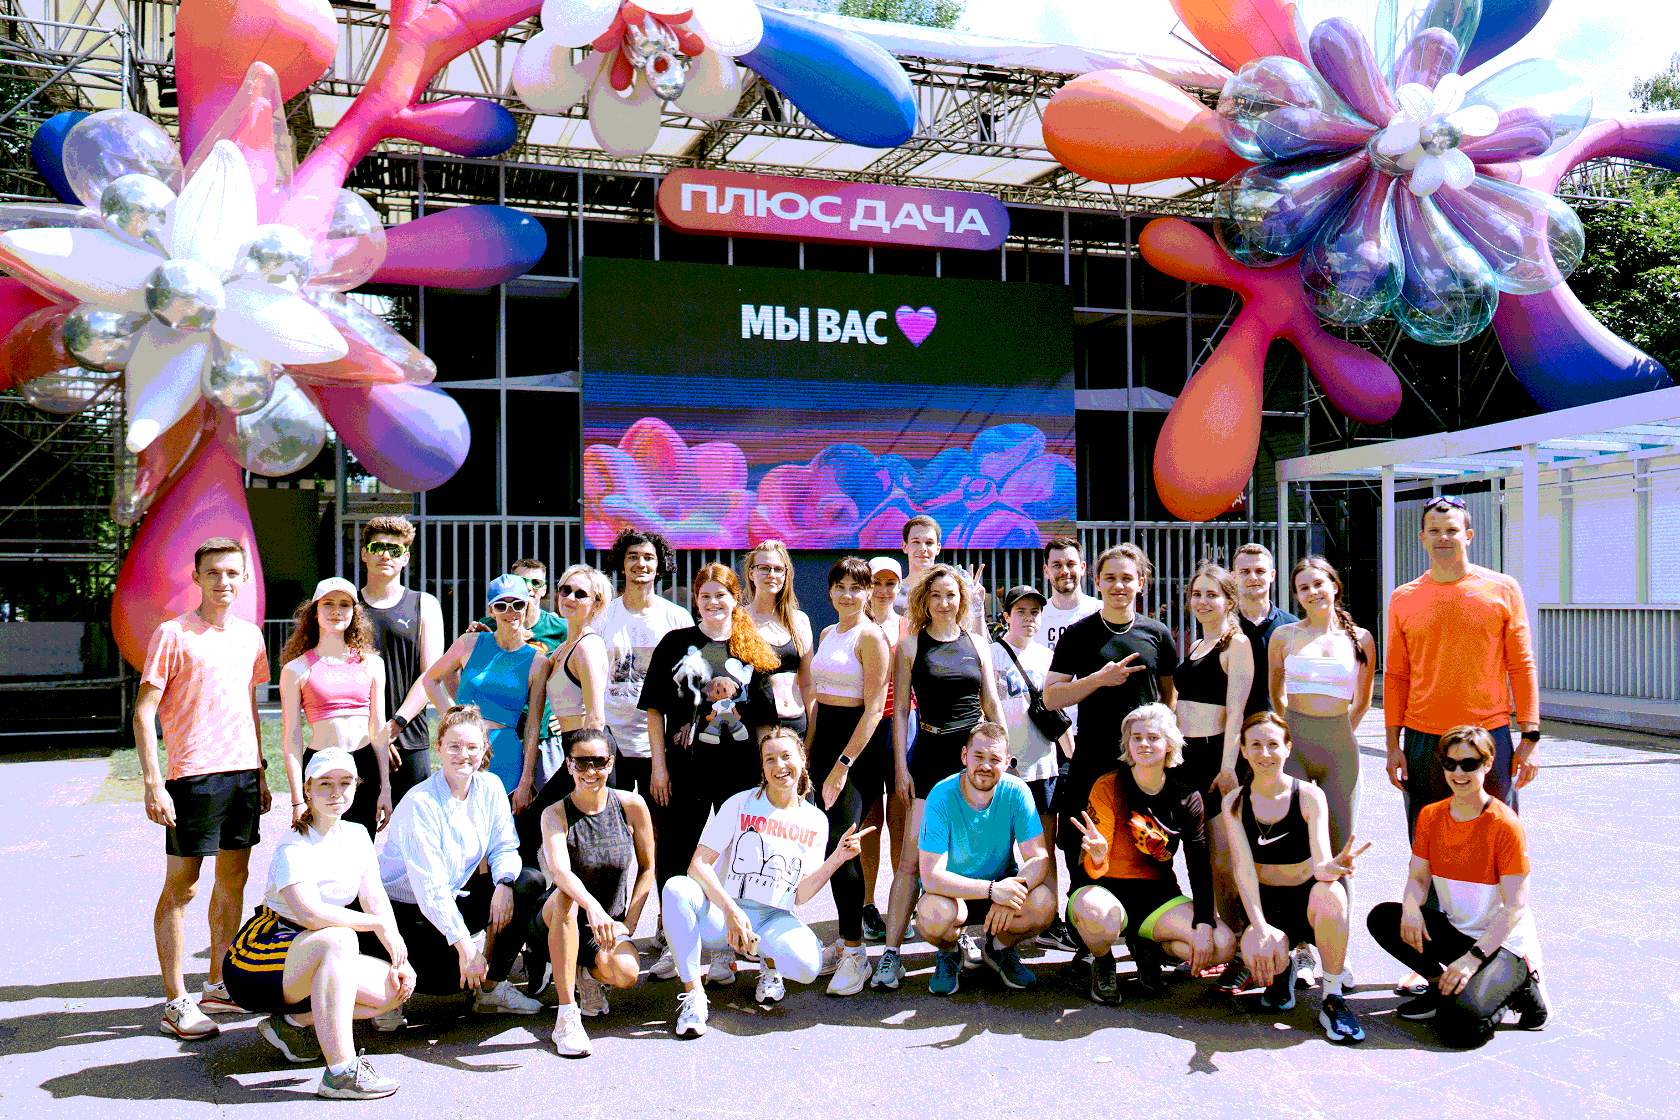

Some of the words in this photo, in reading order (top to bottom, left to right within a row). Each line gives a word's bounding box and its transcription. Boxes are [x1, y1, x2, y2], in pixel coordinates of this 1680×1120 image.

[681, 183, 842, 224] ПЛЮС
[850, 198, 991, 236] ДАЧА
[741, 303, 810, 342] МЫ
[817, 307, 888, 345] ВАС
[740, 813, 818, 848] WORKOUT
